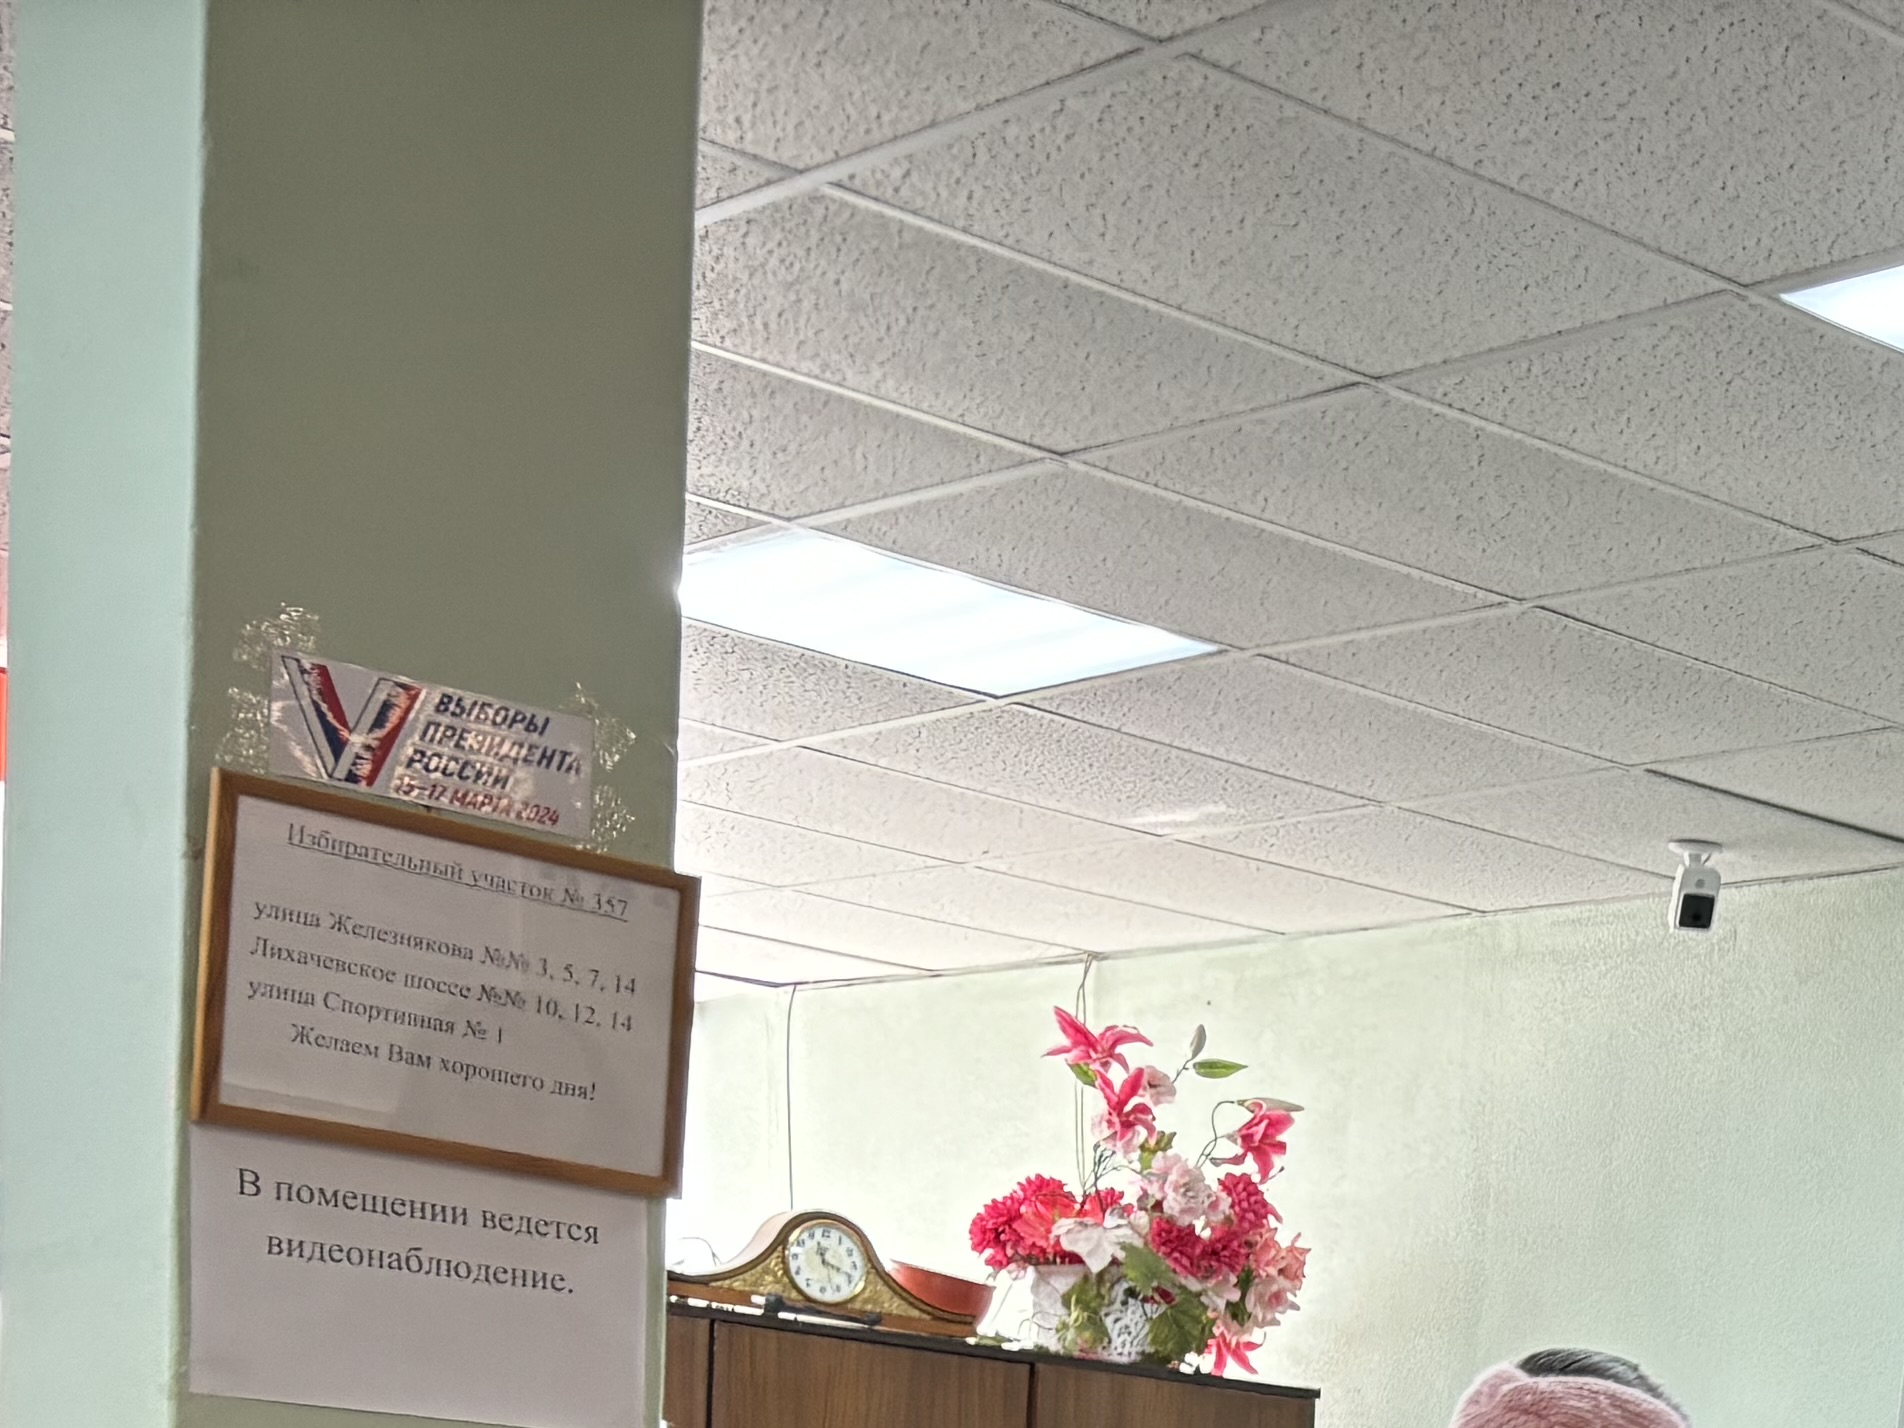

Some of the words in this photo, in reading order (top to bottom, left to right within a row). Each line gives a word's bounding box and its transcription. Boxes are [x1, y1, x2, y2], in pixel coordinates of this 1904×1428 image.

[434, 691, 551, 737] ВЫБОРЫ
[405, 749, 511, 790] РОССИИ
[449, 787, 513, 816] МАРТА
[516, 804, 560, 826] 2024
[288, 823, 463, 881] Избирательный
[471, 868, 555, 901] участок
[563, 887, 584, 906] №
[594, 893, 628, 916] 357
[253, 901, 321, 928] улица
[329, 912, 473, 961] Железнякова
[615, 974, 636, 995] 14
[248, 980, 315, 1007] улица
[323, 991, 455, 1036] Спортивная
[462, 1019, 487, 1041] №
[250, 936, 397, 983] Лихачевское
[404, 973, 471, 998] шоссе
[612, 1011, 632, 1032] 14
[291, 1023, 379, 1059] Желаем
[388, 1043, 431, 1070] Вам
[440, 1056, 544, 1091] хорошего
[550, 1079, 596, 1101] дня!
[237, 1167, 261, 1197] В
[274, 1179, 468, 1228] помещении
[481, 1208, 600, 1245] ведется
[266, 1234, 574, 1295] видеонаблюдение.
